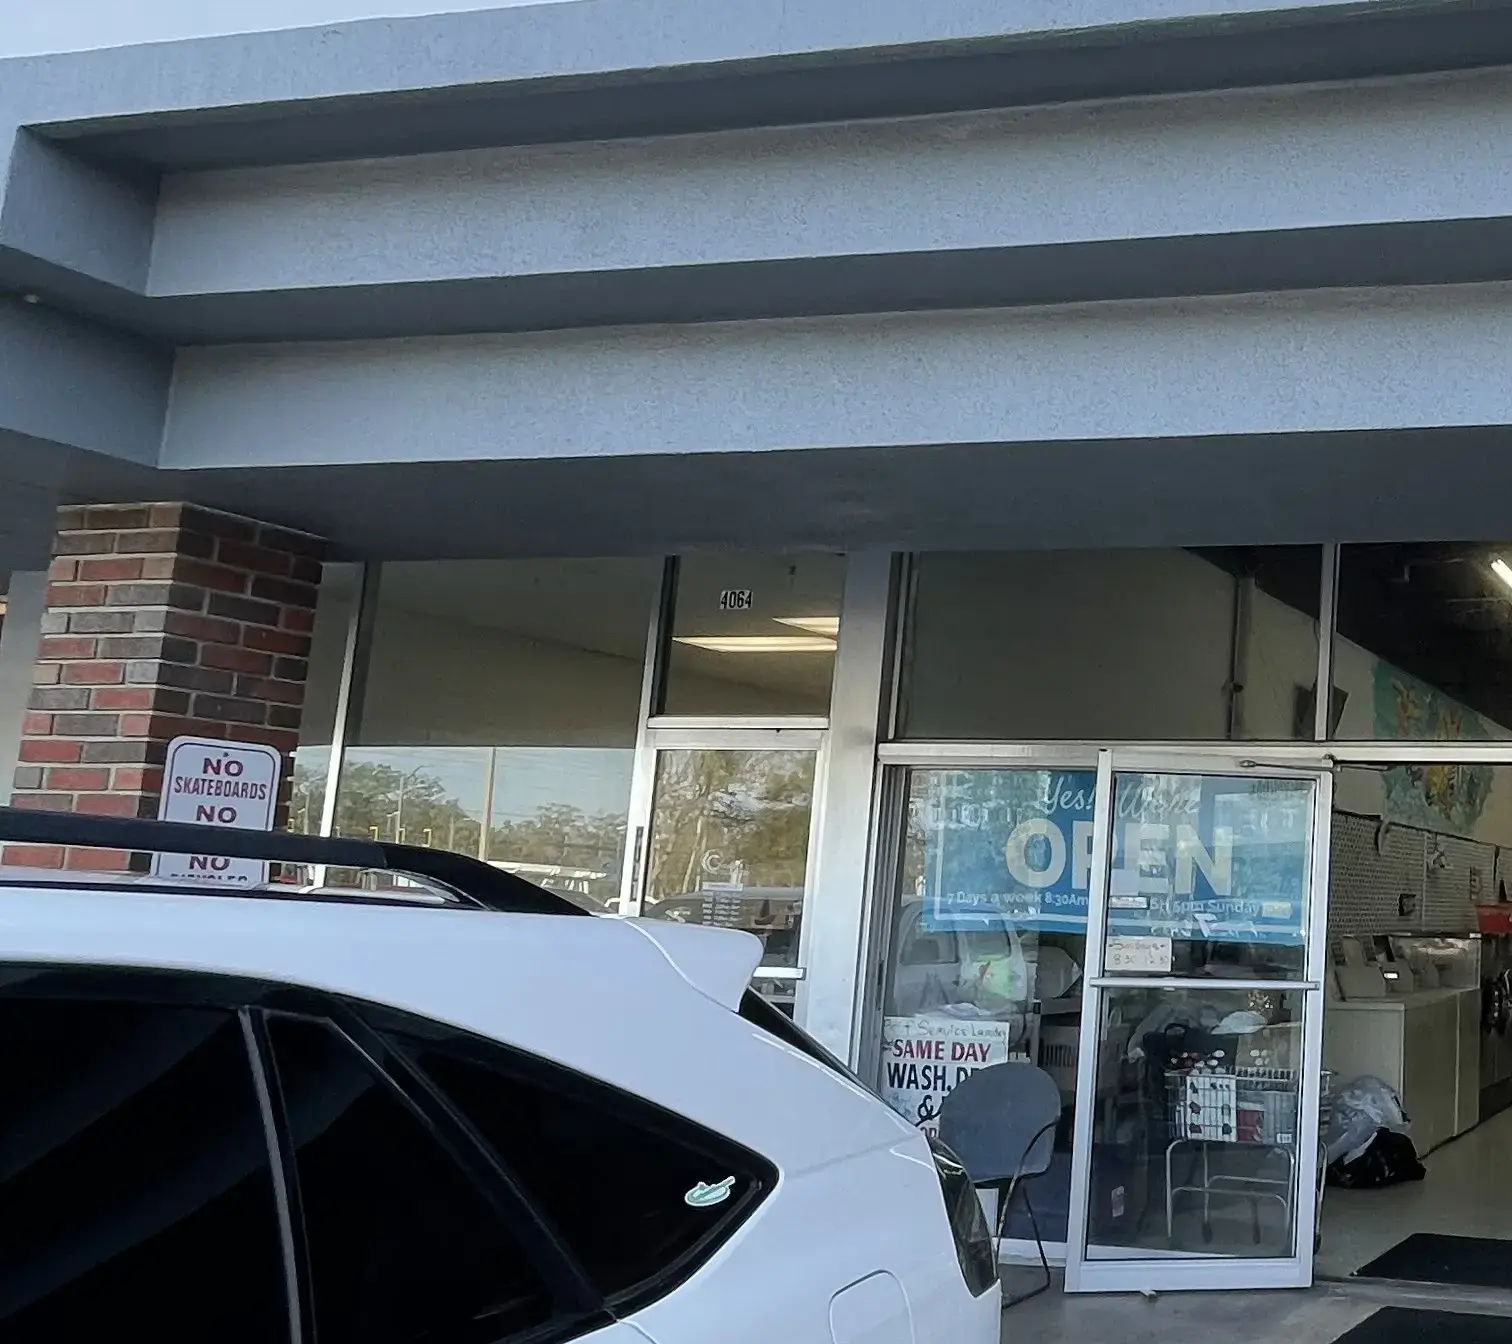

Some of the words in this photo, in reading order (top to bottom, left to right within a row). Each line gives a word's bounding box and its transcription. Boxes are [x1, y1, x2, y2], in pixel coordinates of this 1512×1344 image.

[721, 590, 752, 609] 4064
[202, 757, 244, 777] NO
[174, 776, 267, 800] SKATEBOARDS
[196, 805, 237, 823] NO
[189, 855, 230, 870] NO
[1005, 818, 1233, 896] OPEN
[956, 892, 986, 906] Days
[893, 1039, 945, 1060] SAME
[951, 1042, 991, 1062] DAY
